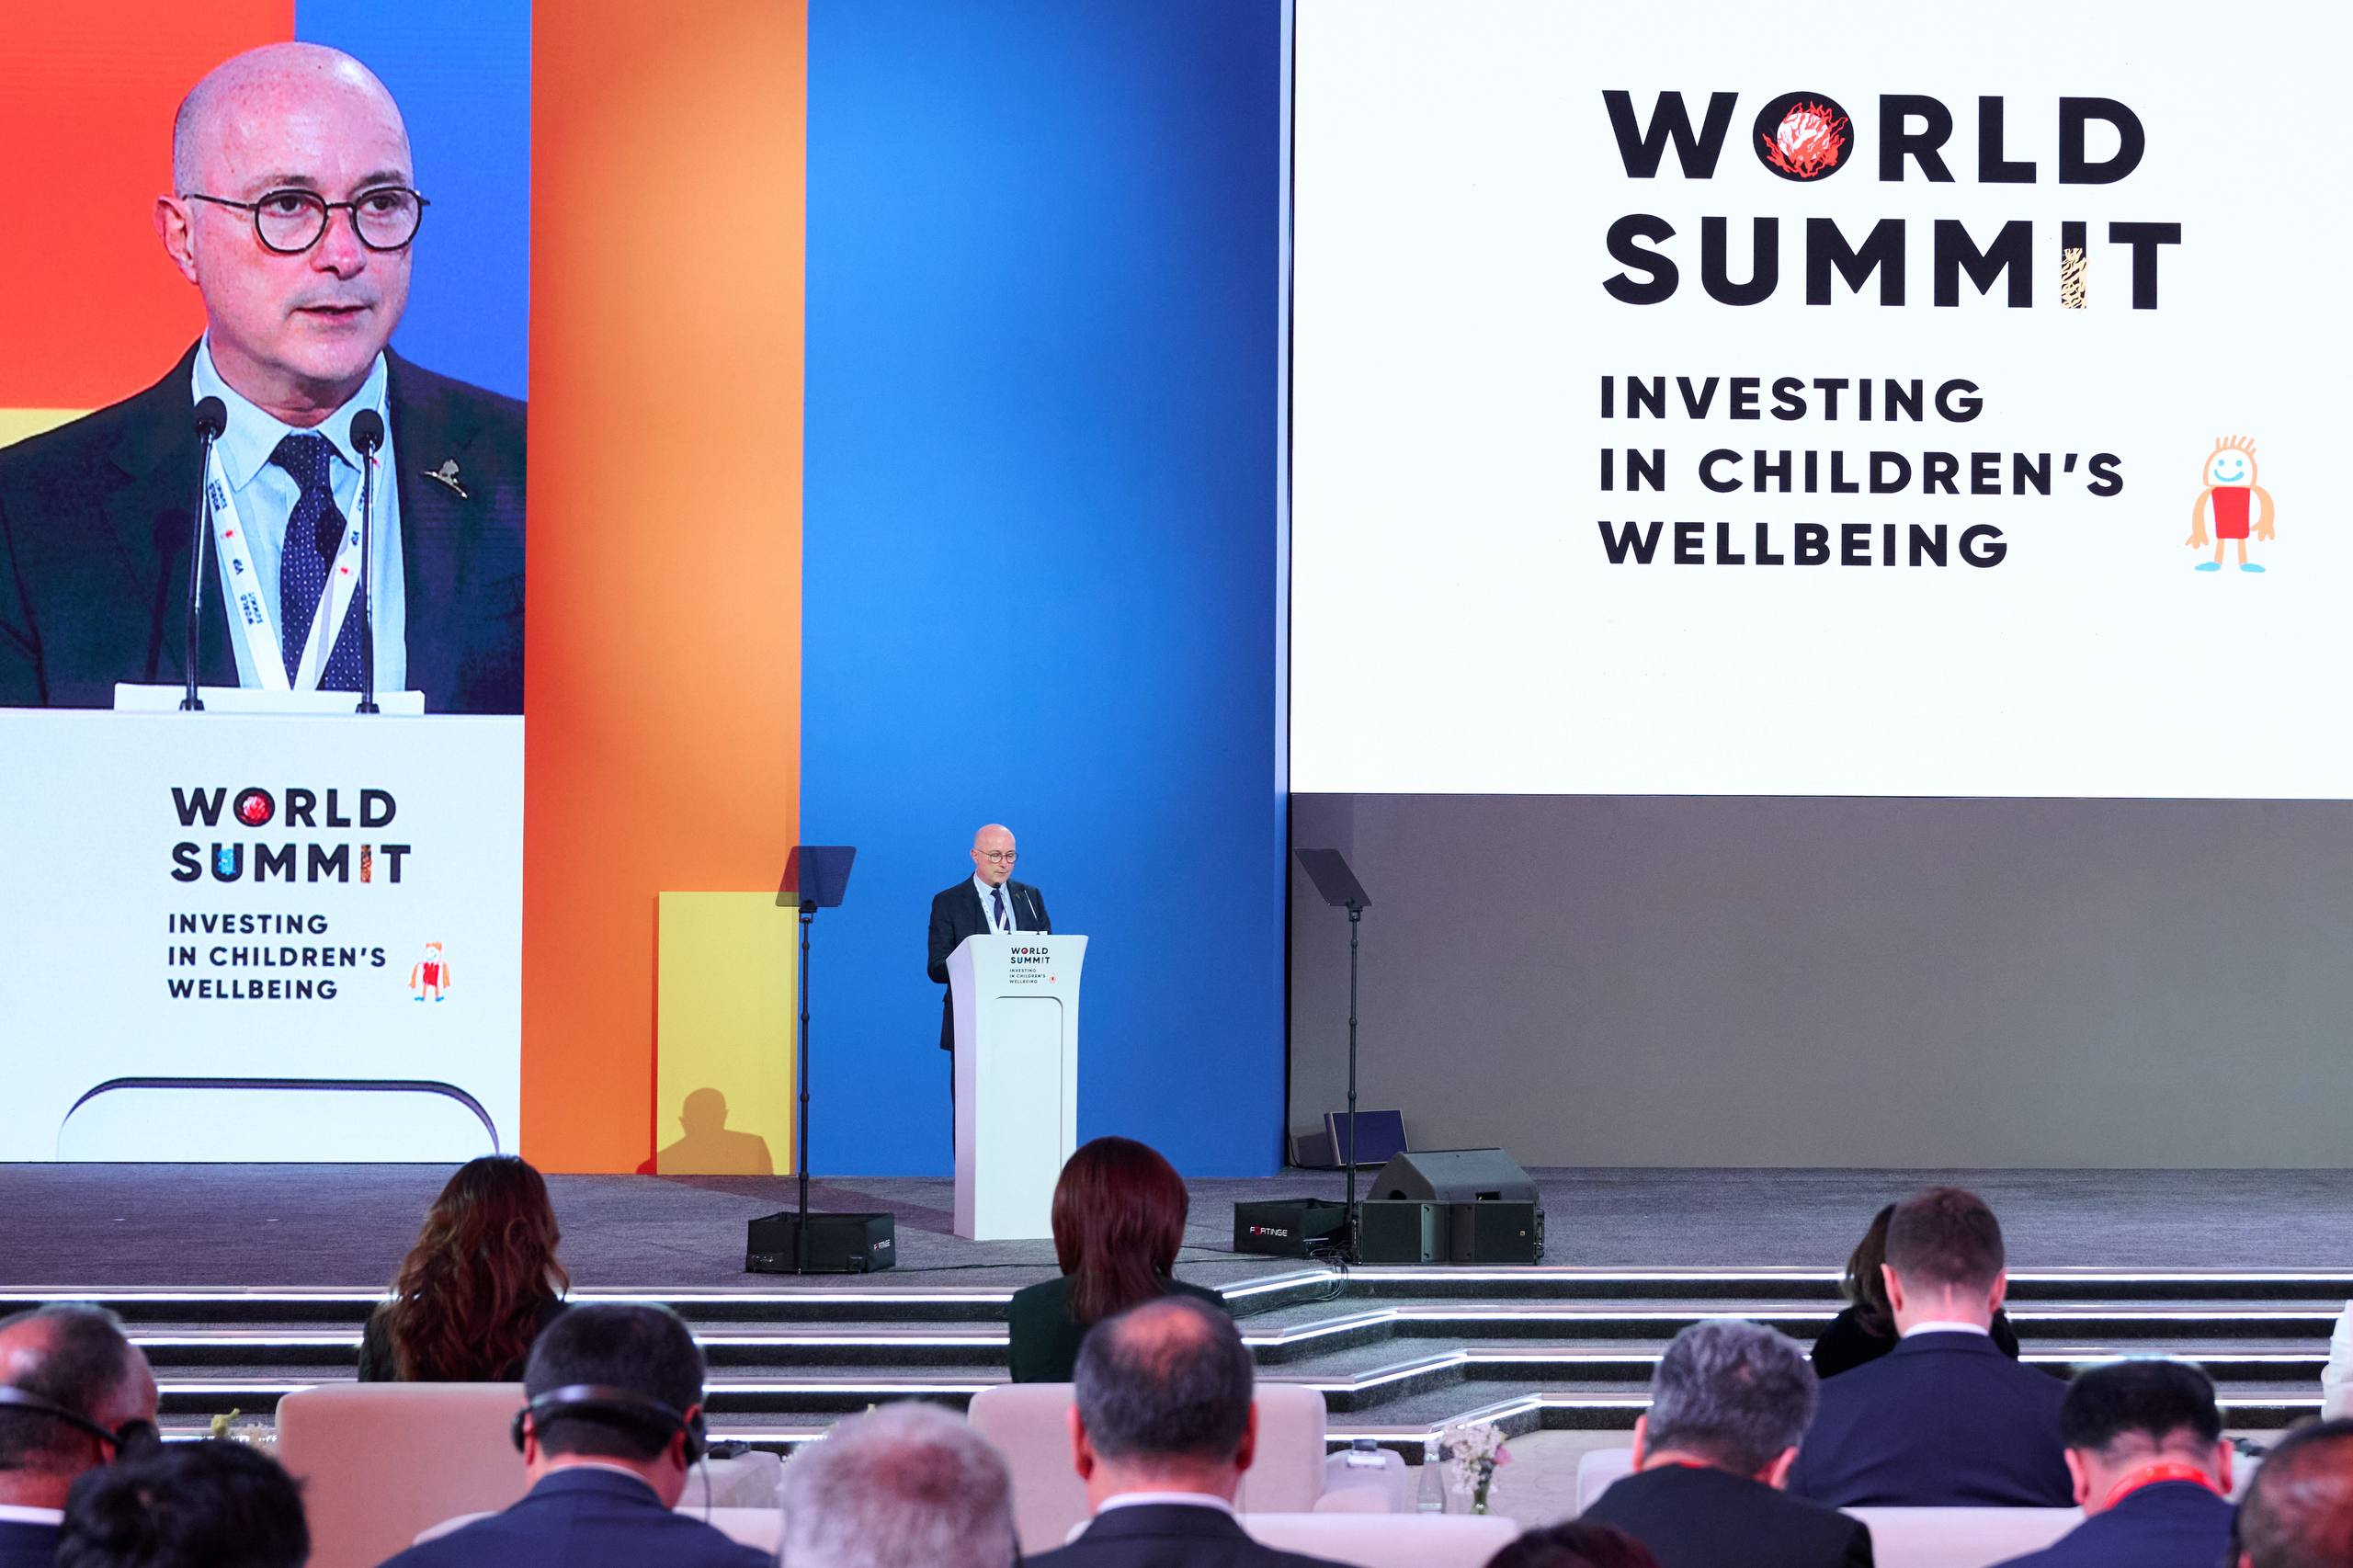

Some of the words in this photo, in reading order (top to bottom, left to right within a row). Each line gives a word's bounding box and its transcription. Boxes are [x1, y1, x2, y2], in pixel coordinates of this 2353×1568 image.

[1602, 90, 2145, 185] WORLD
[1602, 214, 2182, 311] SUMMIT
[1600, 375, 1984, 423] INVESTING
[1600, 449, 1665, 492] IN
[1699, 449, 2124, 497] CHILDREN'S
[1598, 521, 2007, 569] WELLBEING
[171, 787, 396, 827] WORLD
[171, 842, 411, 883] SUMMIT
[168, 914, 328, 935] INVESTING
[168, 947, 196, 966] IN
[210, 947, 386, 967] CHILDREN'S
[167, 979, 337, 999] WELLBEING
